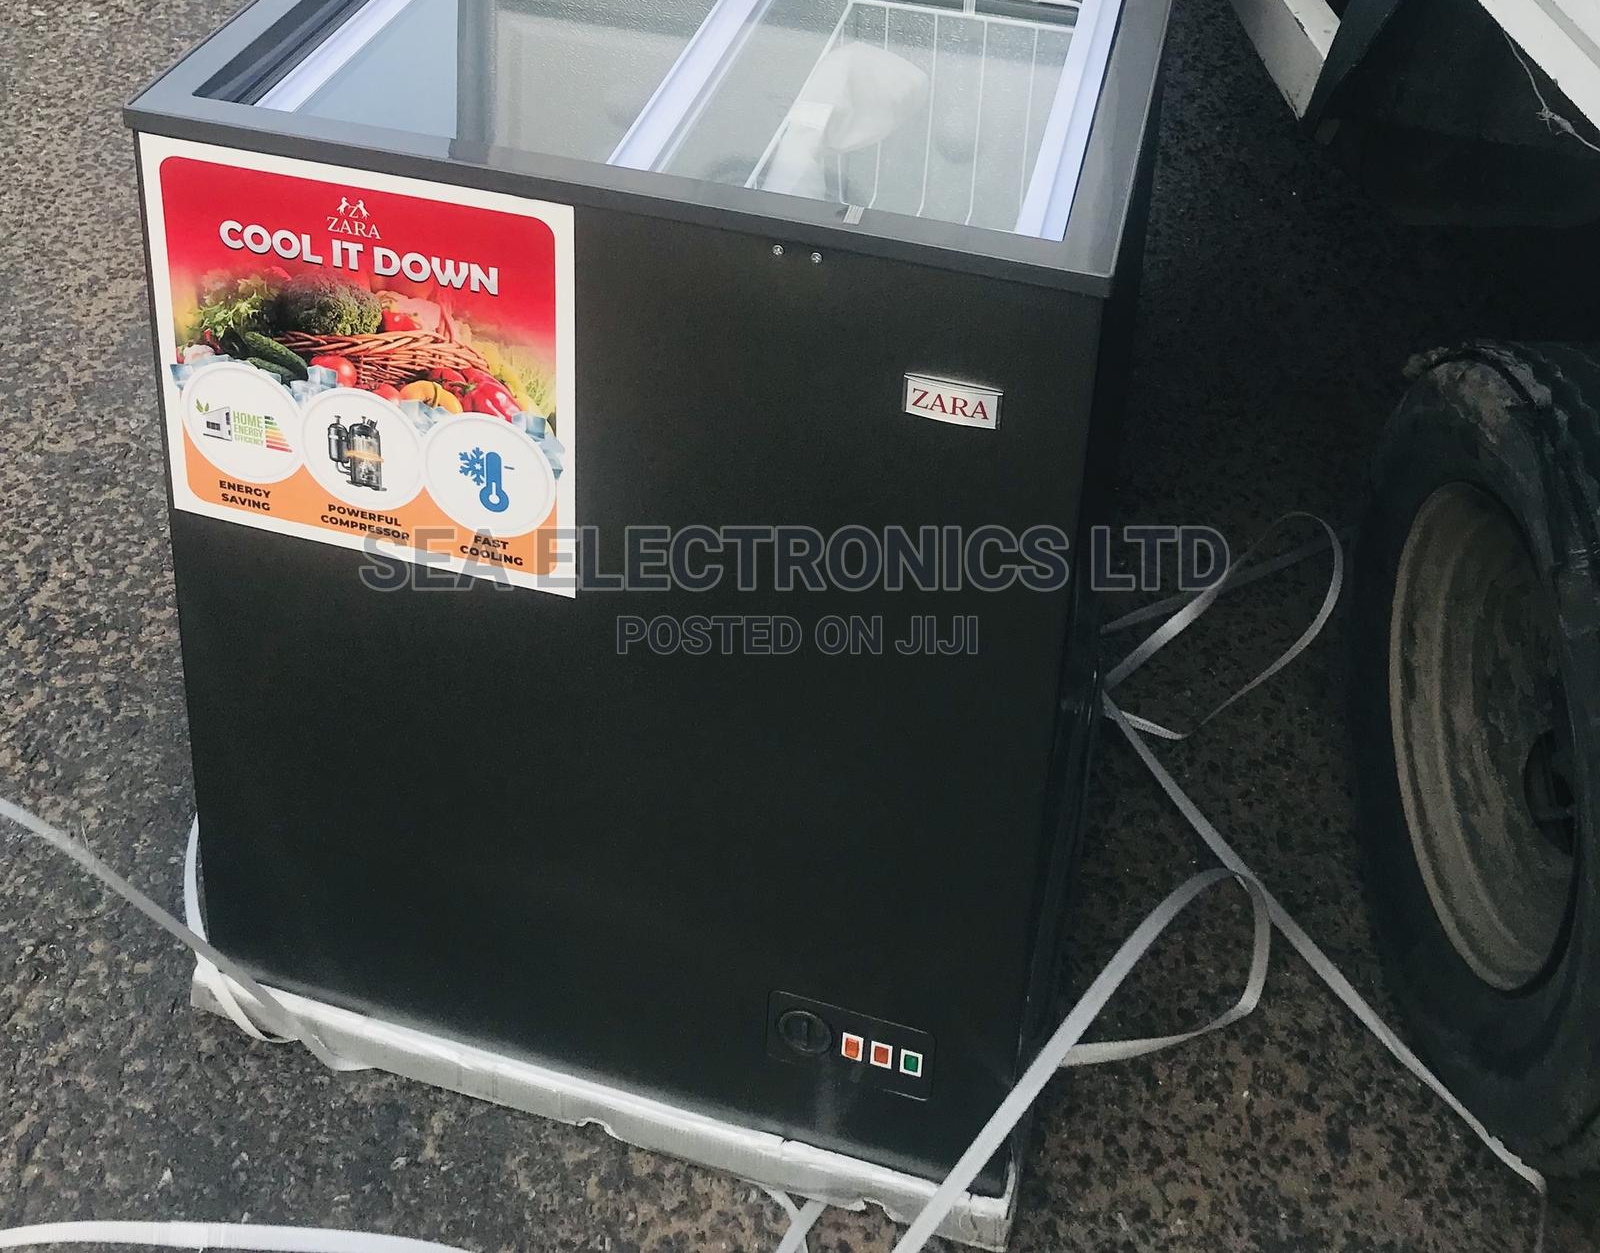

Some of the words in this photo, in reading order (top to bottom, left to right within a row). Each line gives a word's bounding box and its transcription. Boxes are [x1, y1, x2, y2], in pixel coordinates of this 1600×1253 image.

[326, 216, 381, 240] ZARA
[218, 219, 323, 265] COOL
[331, 239, 364, 271] IT
[373, 246, 499, 296] DOWN
[911, 387, 989, 420] ZARA
[233, 410, 263, 429] HOME
[233, 424, 264, 439] ENERGY
[219, 479, 271, 499] ENERGY
[221, 492, 271, 511] SAVING
[327, 503, 402, 527] POWERFUL
[320, 514, 410, 541] COMPRESSOR
[473, 534, 509, 550] FAST
[459, 544, 524, 566] COOLING
